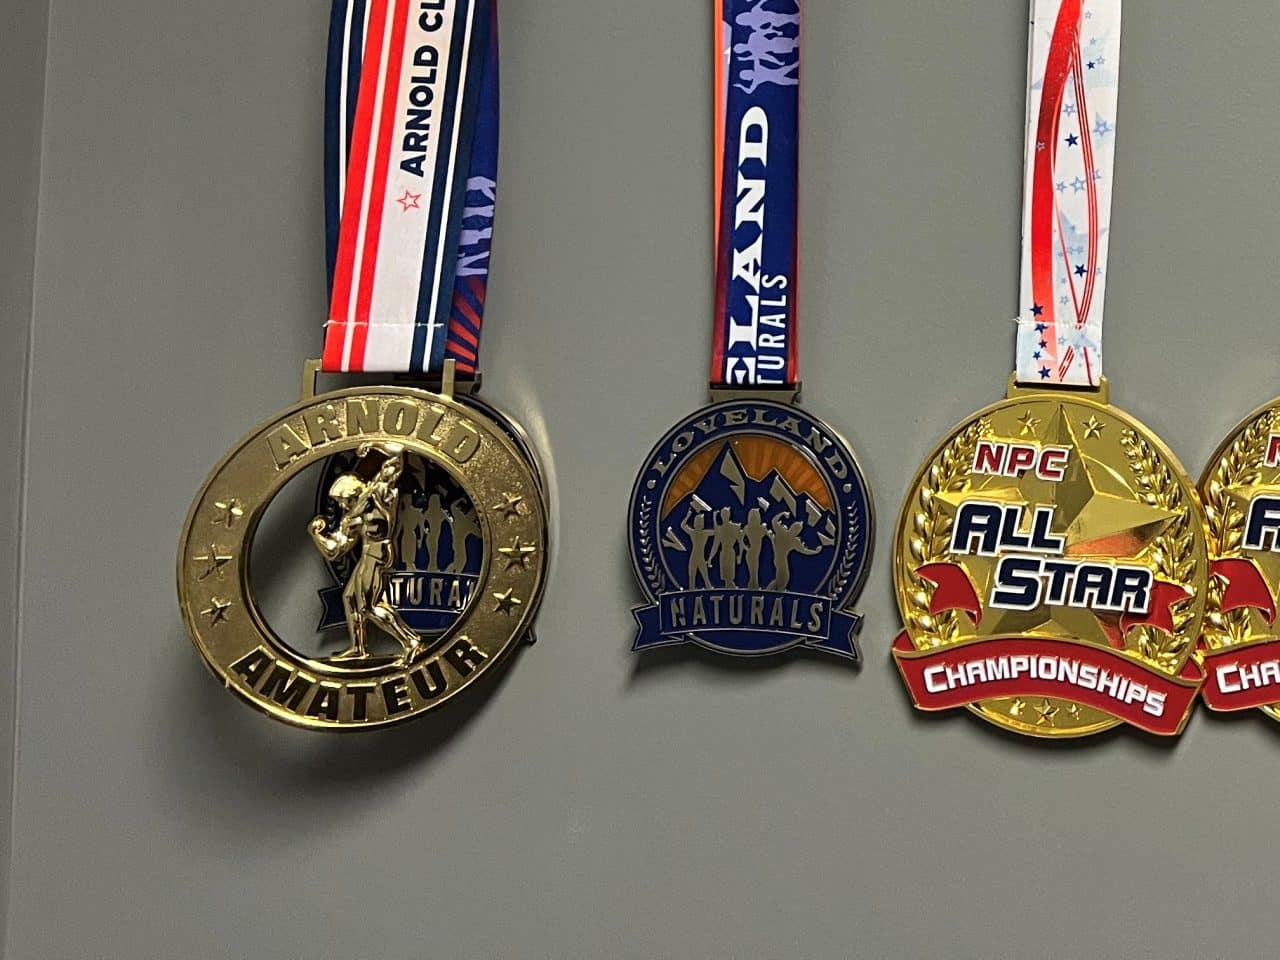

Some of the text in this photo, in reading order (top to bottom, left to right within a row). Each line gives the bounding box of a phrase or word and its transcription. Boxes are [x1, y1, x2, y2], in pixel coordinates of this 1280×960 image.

[399, 44, 440, 178] ARNOLD
[265, 399, 482, 470] ARNOLD
[652, 408, 850, 480] LOVELAND
[971, 438, 1072, 482] NPC
[951, 503, 1065, 556] ALL
[670, 595, 824, 633] NATURALS
[989, 553, 1153, 614] STAR
[228, 635, 490, 724] AMATEUR
[923, 655, 1166, 717] CHAMPIONSHIPS
